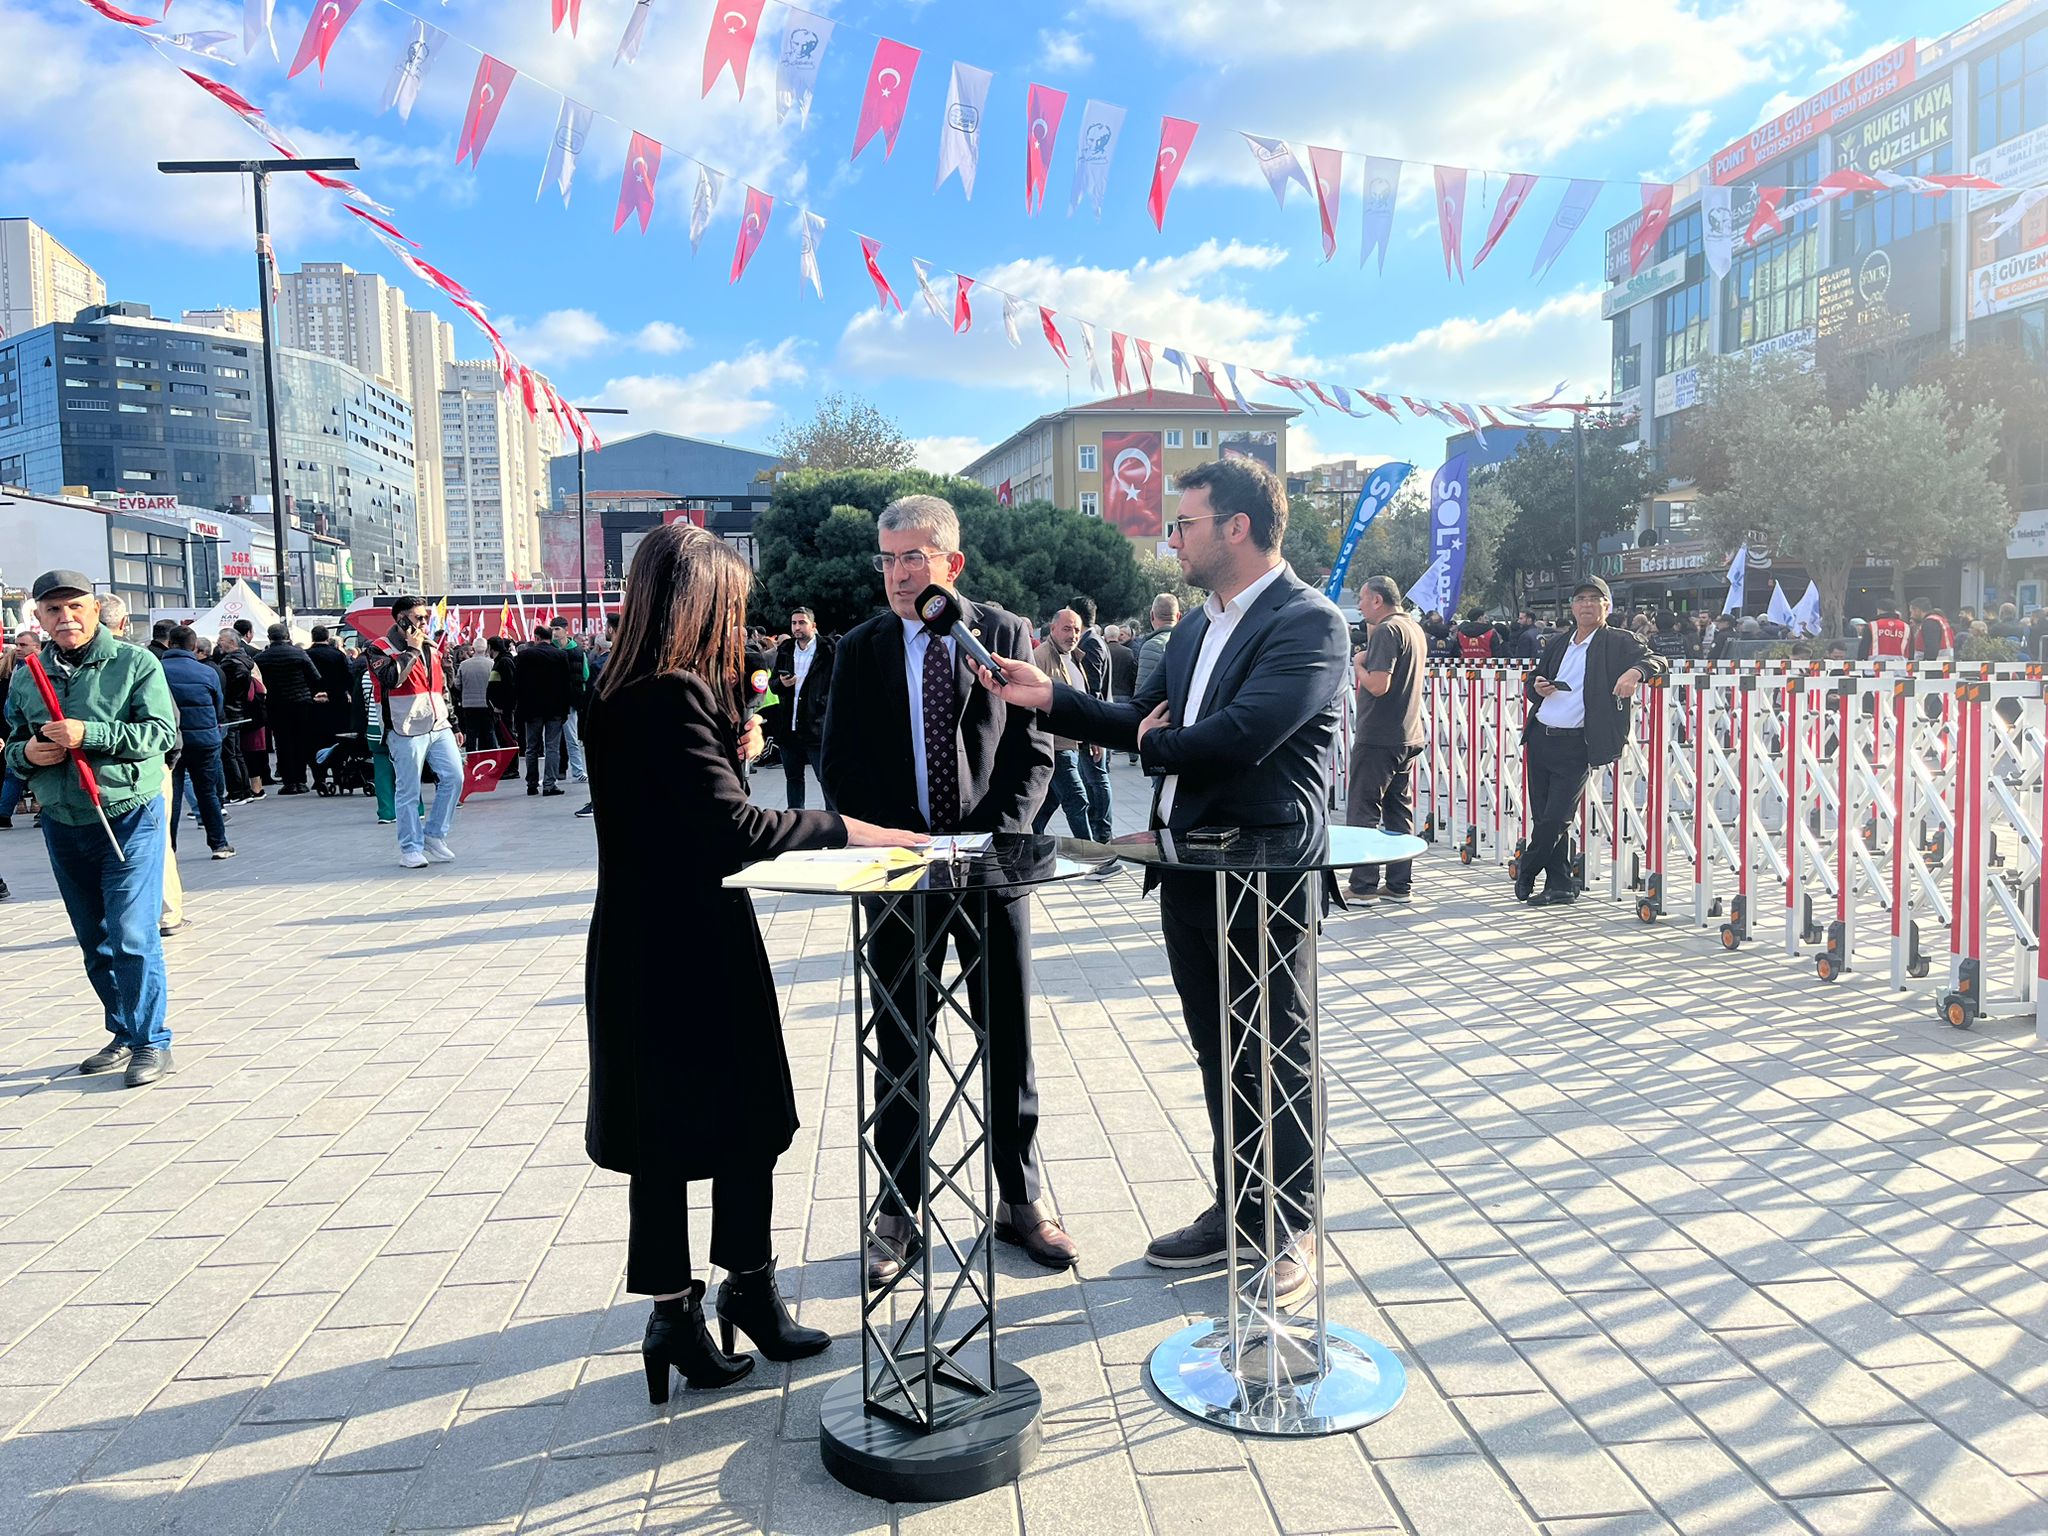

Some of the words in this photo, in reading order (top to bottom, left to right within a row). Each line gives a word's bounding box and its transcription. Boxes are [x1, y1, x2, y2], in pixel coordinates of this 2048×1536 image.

[1854, 48, 1905, 94] KURSU
[1863, 103, 1910, 148] RUKEN
[1913, 82, 1953, 123] KAYA
[1868, 114, 1949, 171] GÜZELLİK
[119, 496, 177, 510] EVBARK
[1436, 480, 1462, 547] SOL
[195, 522, 220, 537] EVBARK
[231, 551, 250, 563] EGE
